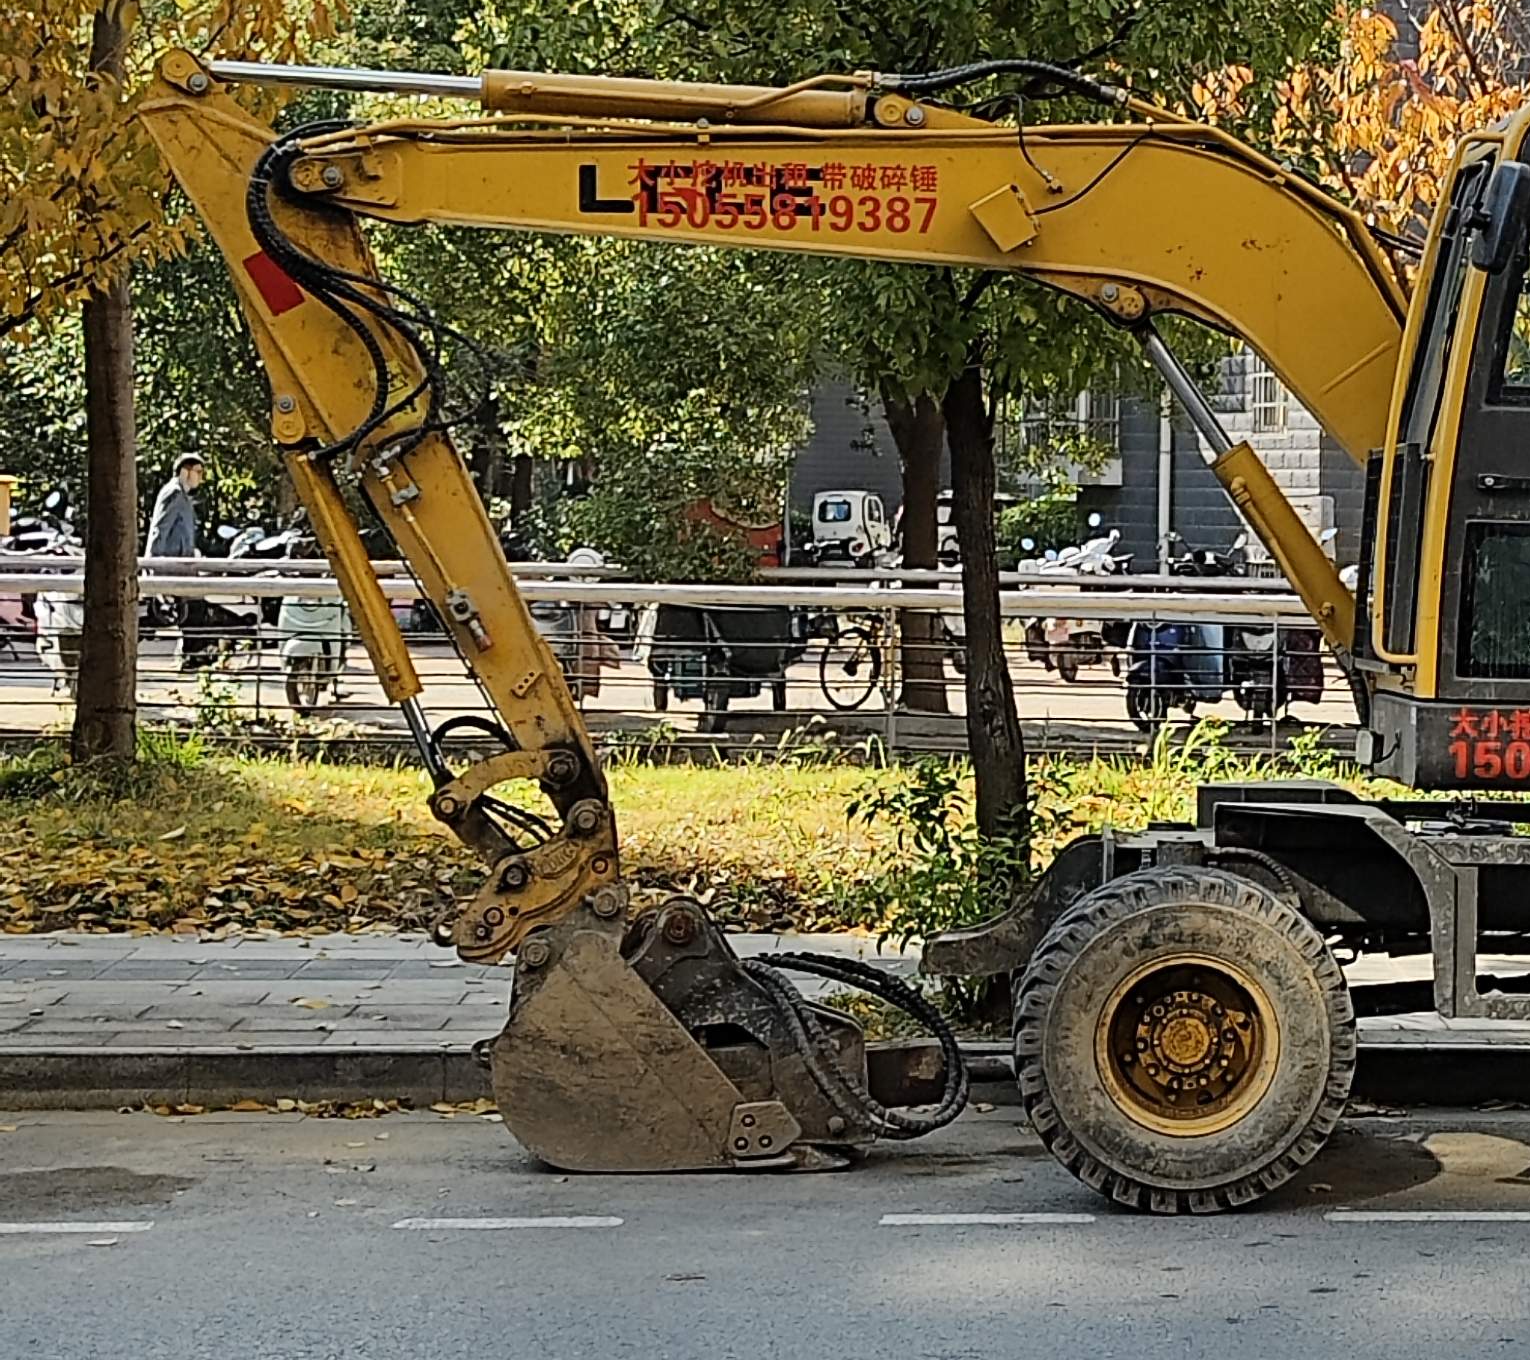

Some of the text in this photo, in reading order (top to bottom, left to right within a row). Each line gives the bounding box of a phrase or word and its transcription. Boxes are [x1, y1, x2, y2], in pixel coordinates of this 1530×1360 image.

[627, 157, 938, 193] 大小挖机出租 带破碎锤
[631, 190, 938, 235] 15055819387
